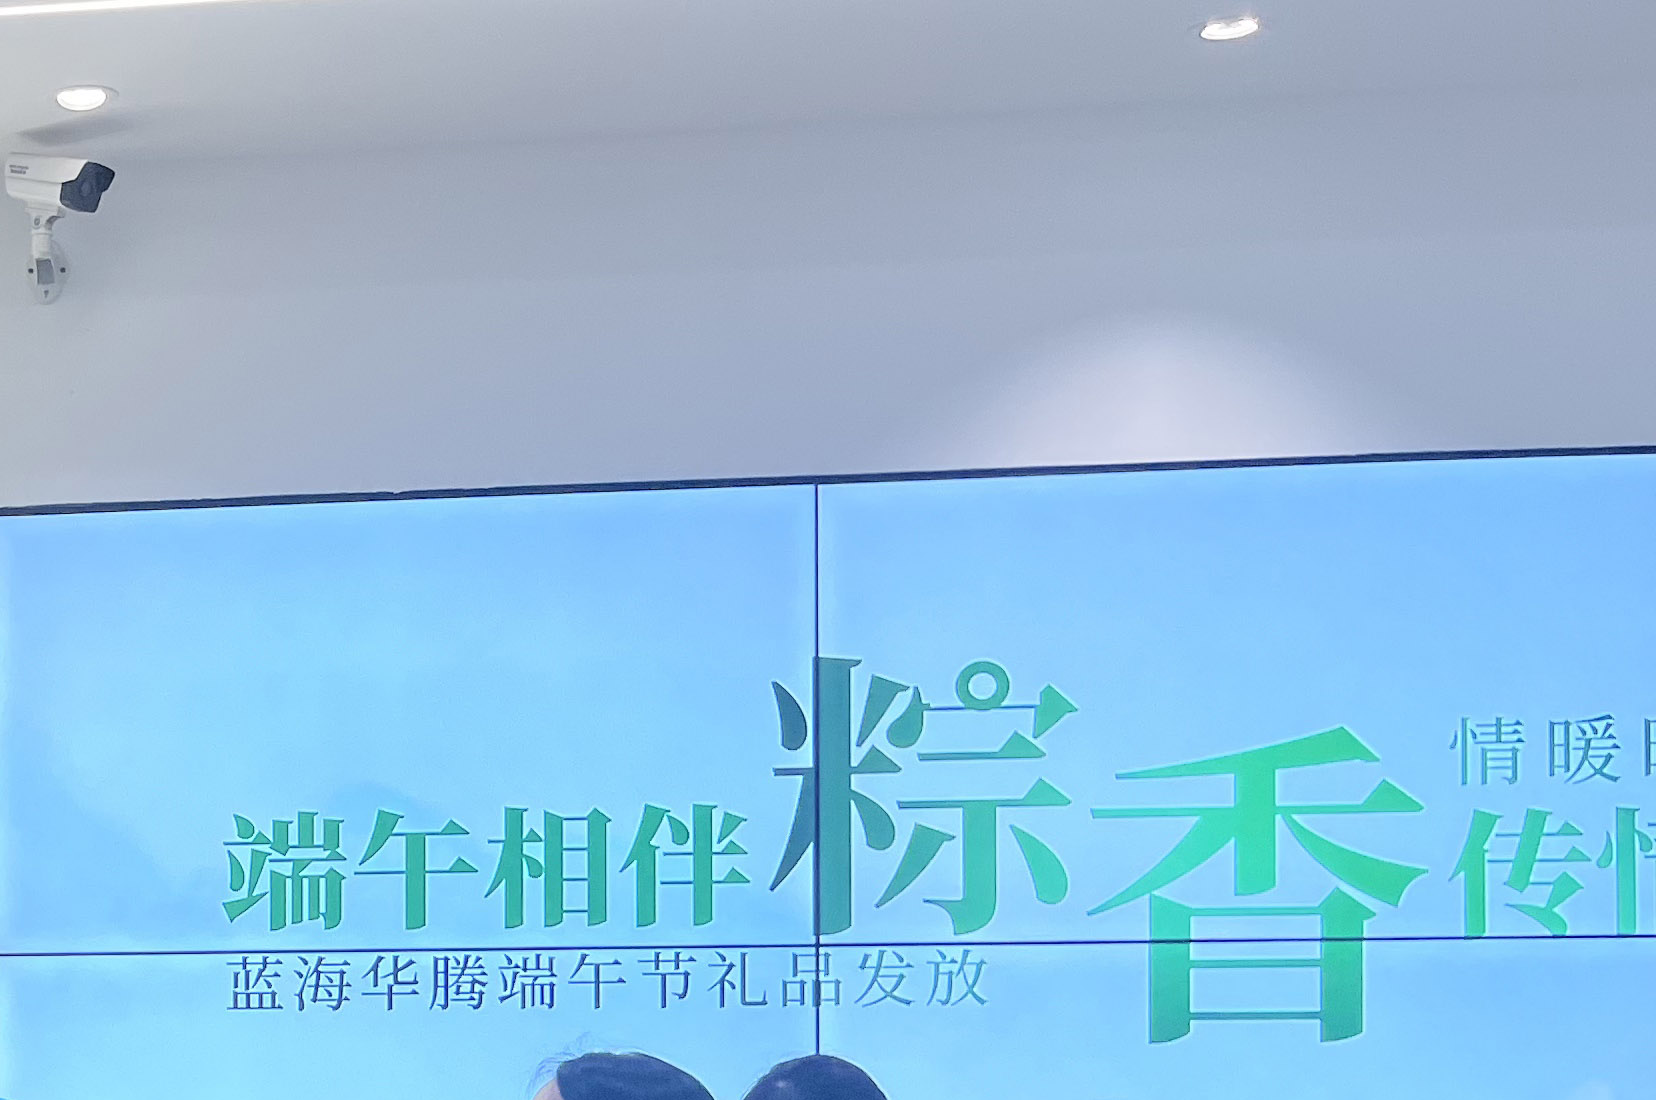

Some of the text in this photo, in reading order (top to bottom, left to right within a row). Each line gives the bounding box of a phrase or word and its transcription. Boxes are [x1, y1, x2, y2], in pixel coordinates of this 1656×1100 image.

[221, 803, 752, 932] 端午相伴
[226, 950, 989, 1013] 蓝海华腾端午节礼品发放
